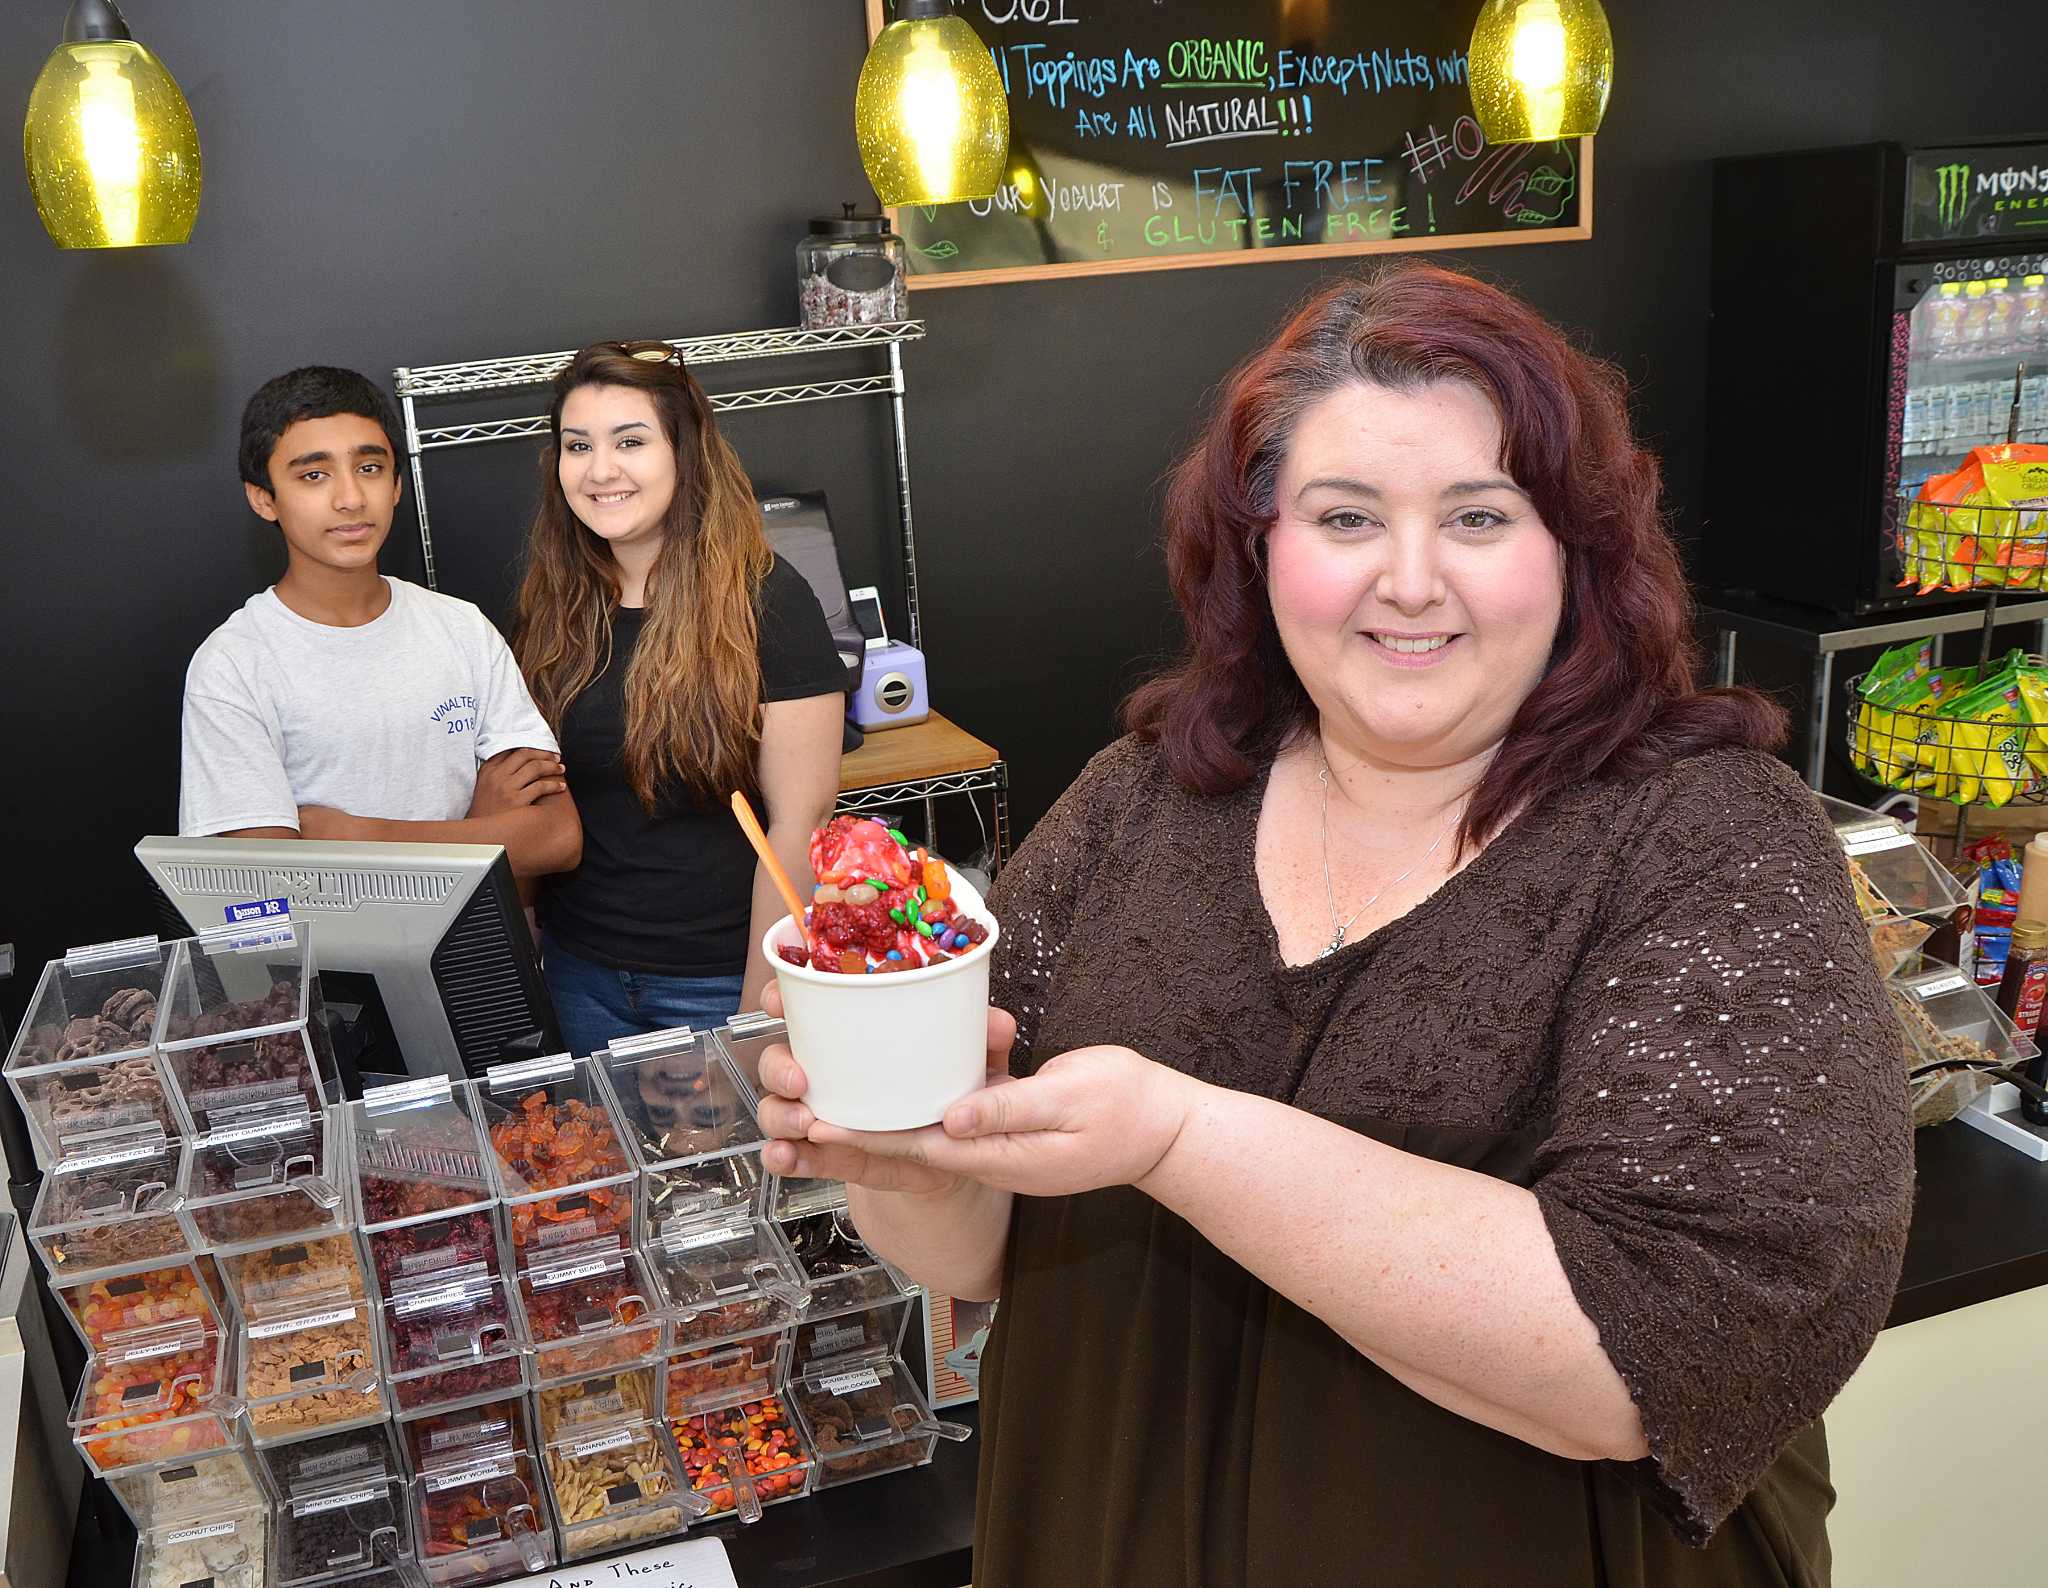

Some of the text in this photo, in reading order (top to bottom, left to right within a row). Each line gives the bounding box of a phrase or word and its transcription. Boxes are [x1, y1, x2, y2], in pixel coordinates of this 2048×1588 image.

[1009, 43, 1116, 109] Toppings
[1121, 48, 1161, 89] Are
[1277, 50, 1371, 96] Except
[1075, 109, 1117, 138] Are
[1127, 105, 1158, 139] All
[1039, 176, 1125, 222] YOGURT
[1152, 182, 1173, 210] IS
[1193, 166, 1263, 219] FAT
[1283, 158, 1389, 211] FREE
[1144, 213, 1303, 247] GLUTEN
[295, 1312, 340, 1326] GRAHAM
[577, 1434, 631, 1453] BANANA CHIPS
[438, 1466, 500, 1486] GUMMY WORMS
[350, 1490, 374, 1500] CHIPS
[168, 1521, 234, 1540] COCONUT CHIPS
[607, 1559, 675, 1579] These
